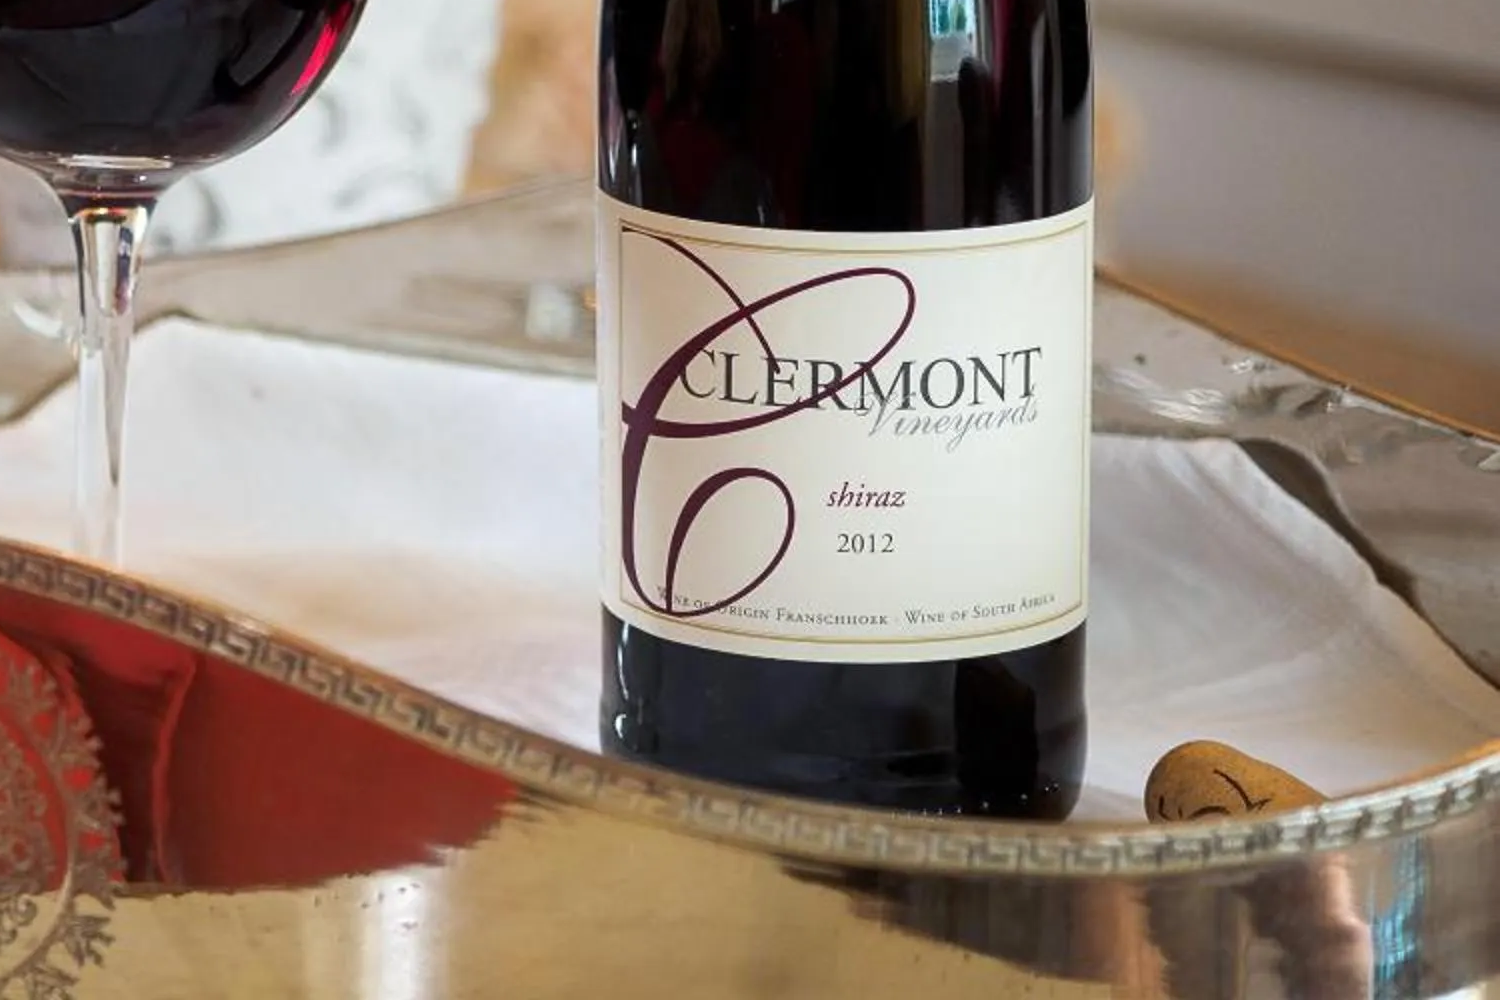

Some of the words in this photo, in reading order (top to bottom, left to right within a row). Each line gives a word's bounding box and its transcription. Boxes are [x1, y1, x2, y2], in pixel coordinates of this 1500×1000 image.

[679, 346, 1043, 411] CLERMONT
[853, 391, 1039, 453] Vineyards
[827, 481, 906, 508] shiraz
[836, 533, 895, 554] 2012
[905, 609, 945, 624] WINE
[972, 603, 1015, 619] SOUTH
